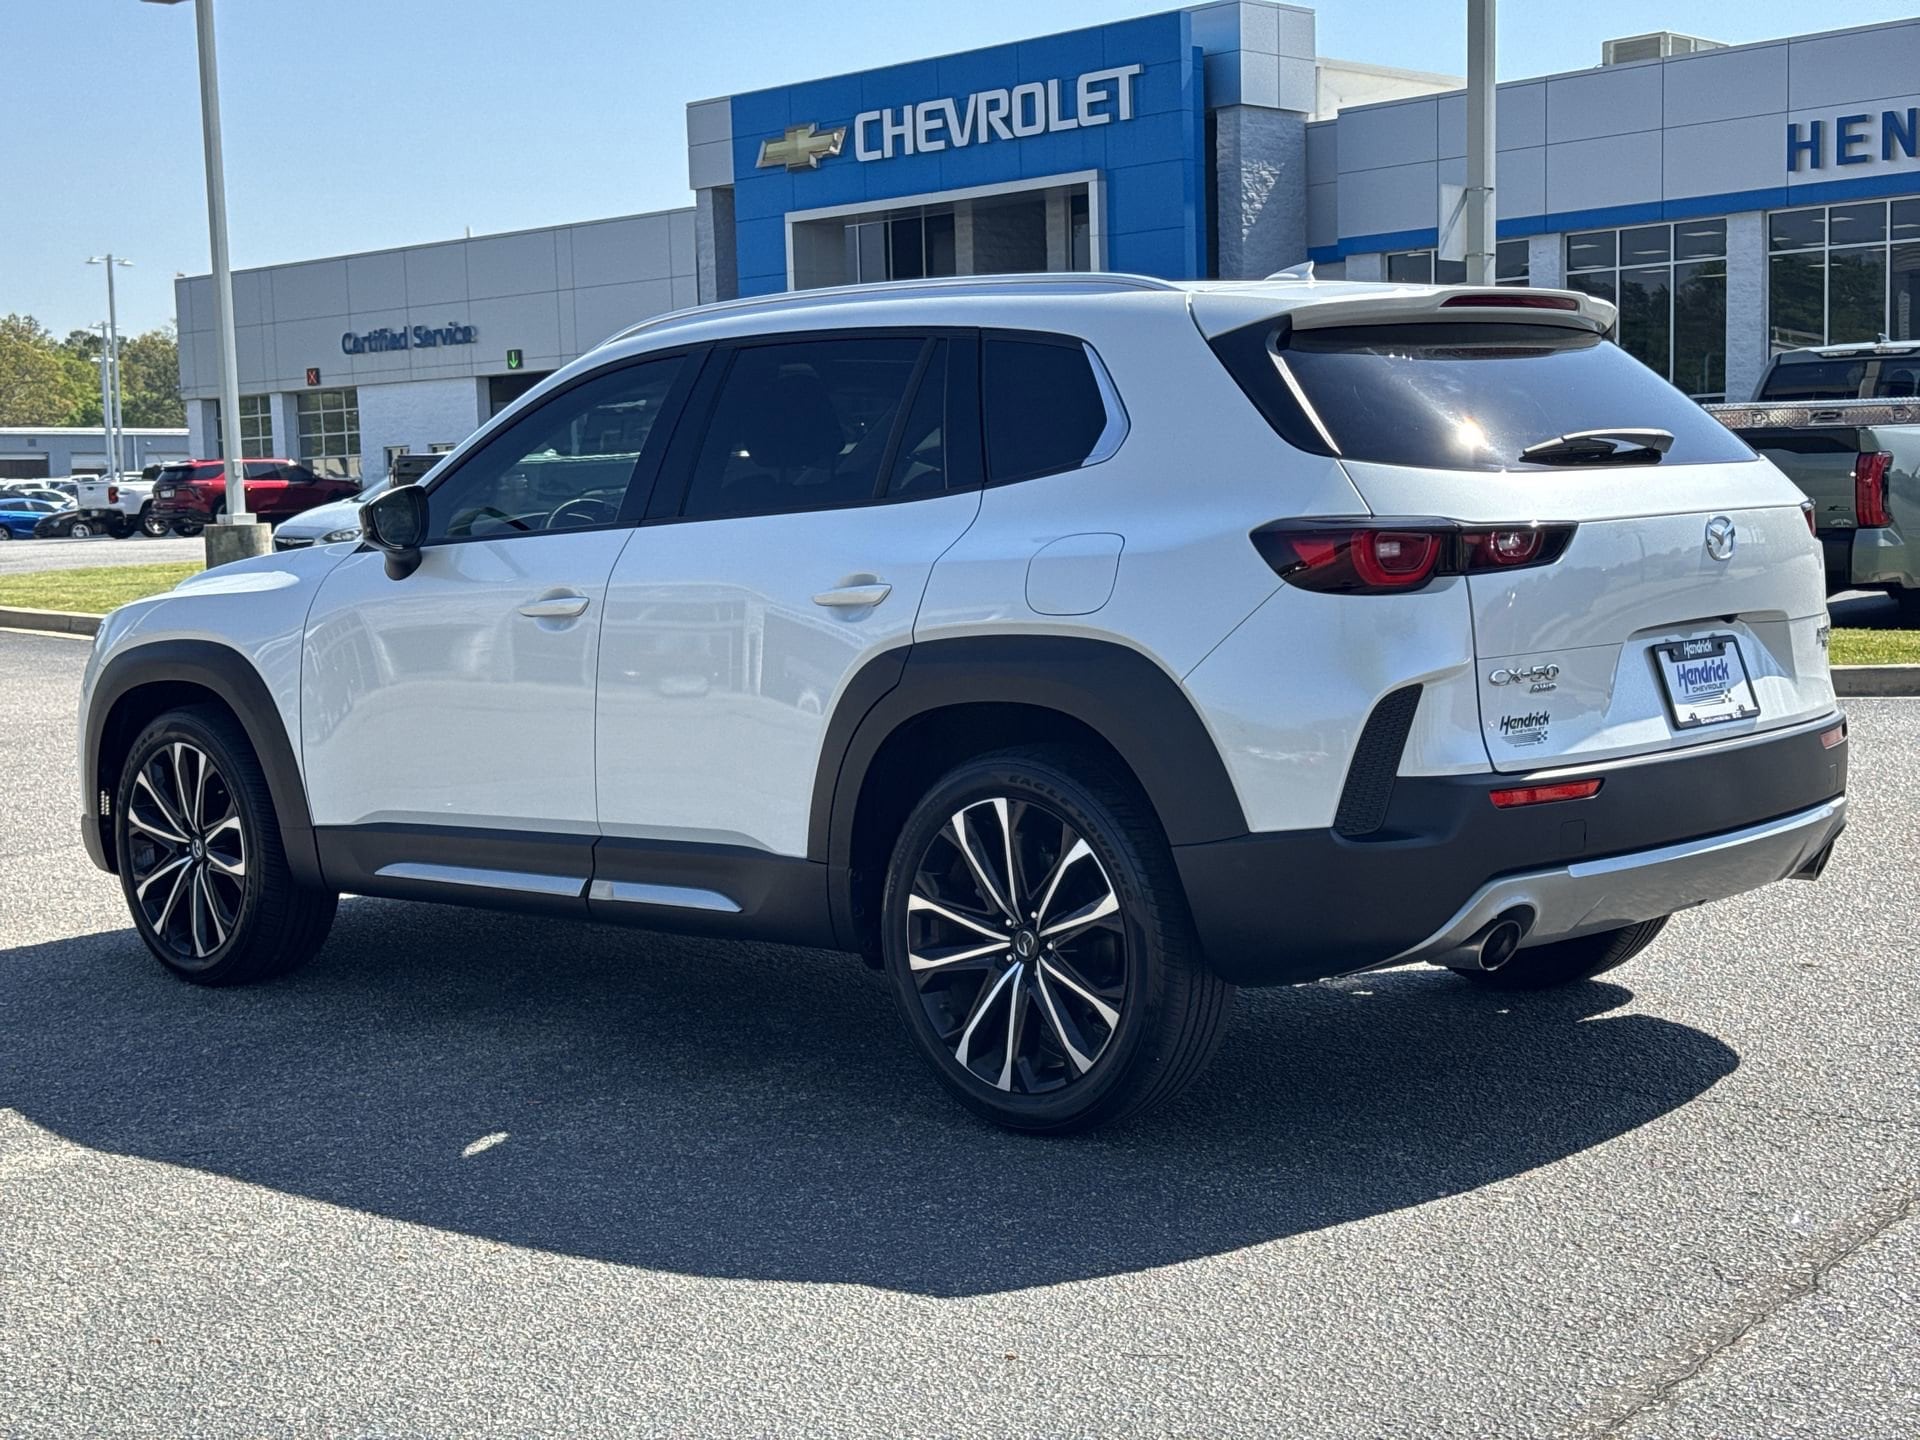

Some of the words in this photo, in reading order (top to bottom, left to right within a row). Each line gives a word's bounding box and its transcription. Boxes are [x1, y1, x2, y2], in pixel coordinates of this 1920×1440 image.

[854, 63, 1142, 163] CHEVROLET
[1787, 107, 1920, 171] HEN
[341, 326, 409, 355] Certified
[413, 321, 476, 349] Service
[1684, 640, 1713, 658] Hendrick
[1488, 663, 1560, 687] CX-50
[1676, 658, 1730, 694] Hendrick
[1691, 681, 1727, 693] CHEVROLET
[1499, 710, 1551, 736] Hendrick
